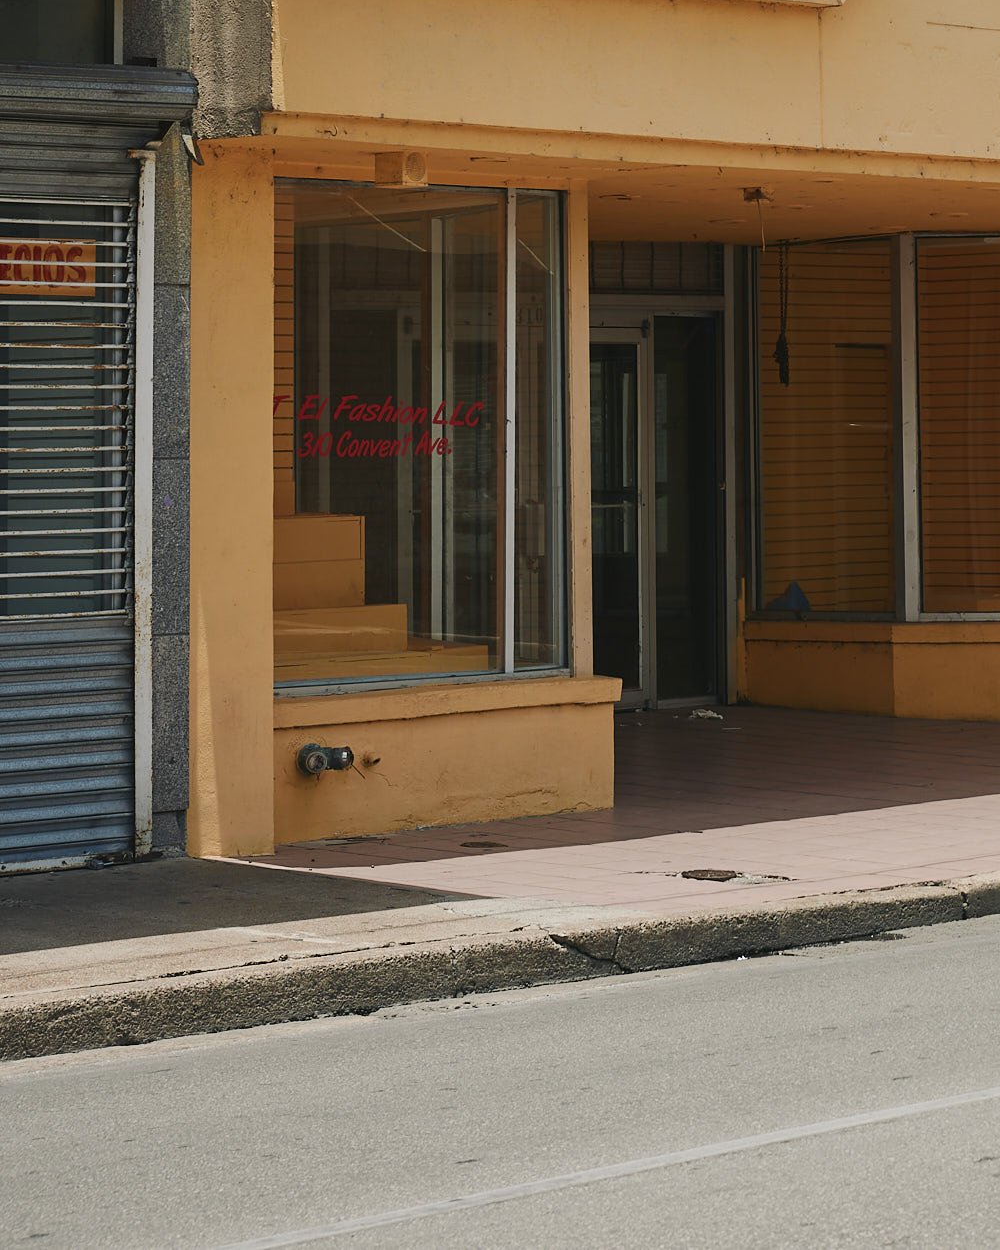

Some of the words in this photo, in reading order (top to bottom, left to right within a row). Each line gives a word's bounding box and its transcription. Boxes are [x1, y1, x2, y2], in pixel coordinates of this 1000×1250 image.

[333, 395, 428, 425] Fashion
[432, 400, 486, 428] LLC
[297, 431, 334, 459] 310
[336, 430, 412, 458] Convent
[414, 430, 453, 457] Ave.
